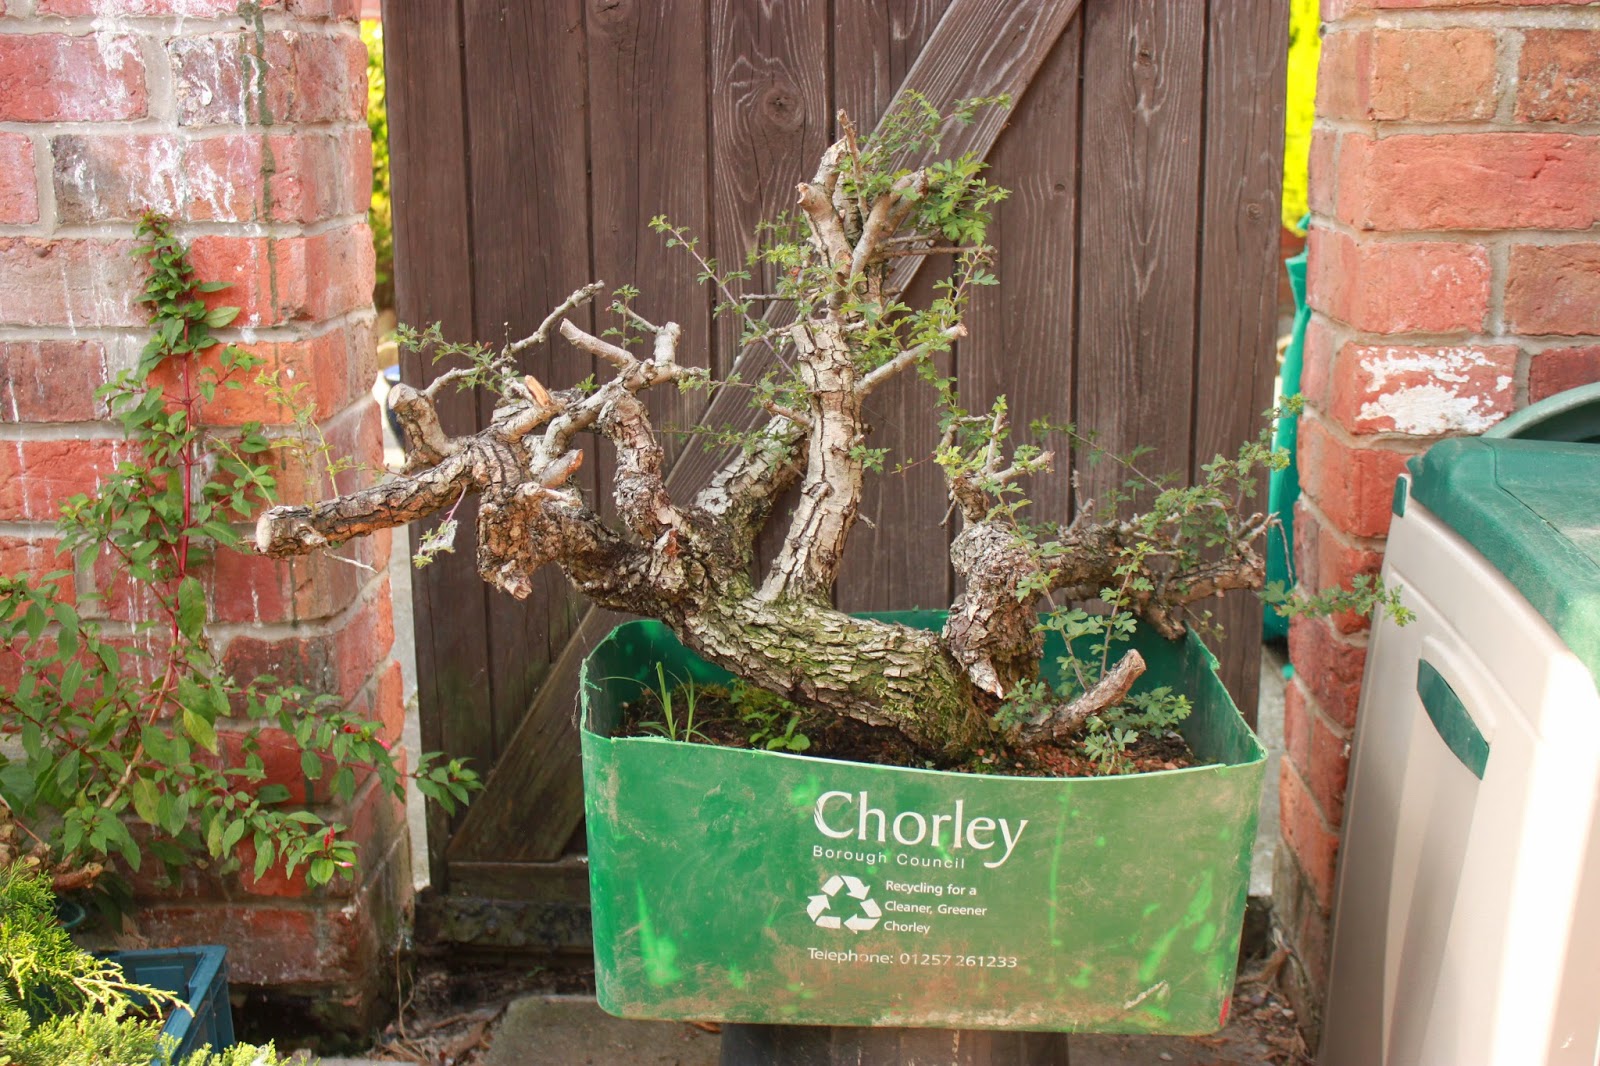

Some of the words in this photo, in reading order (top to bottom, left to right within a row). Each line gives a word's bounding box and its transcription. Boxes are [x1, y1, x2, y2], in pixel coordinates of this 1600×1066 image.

[813, 790, 1029, 869] Chorley
[812, 845, 887, 865] Borough
[896, 853, 965, 869] Council
[885, 880, 943, 897] Recycling
[947, 883, 966, 896] for
[969, 887, 977, 896] a
[884, 901, 933, 915] Cleaner,
[937, 904, 988, 916] Greener
[883, 920, 931, 934] Chorley
[807, 947, 894, 966] Telephone:
[899, 952, 951, 966] 01257
[955, 955, 1018, 968] 261233
